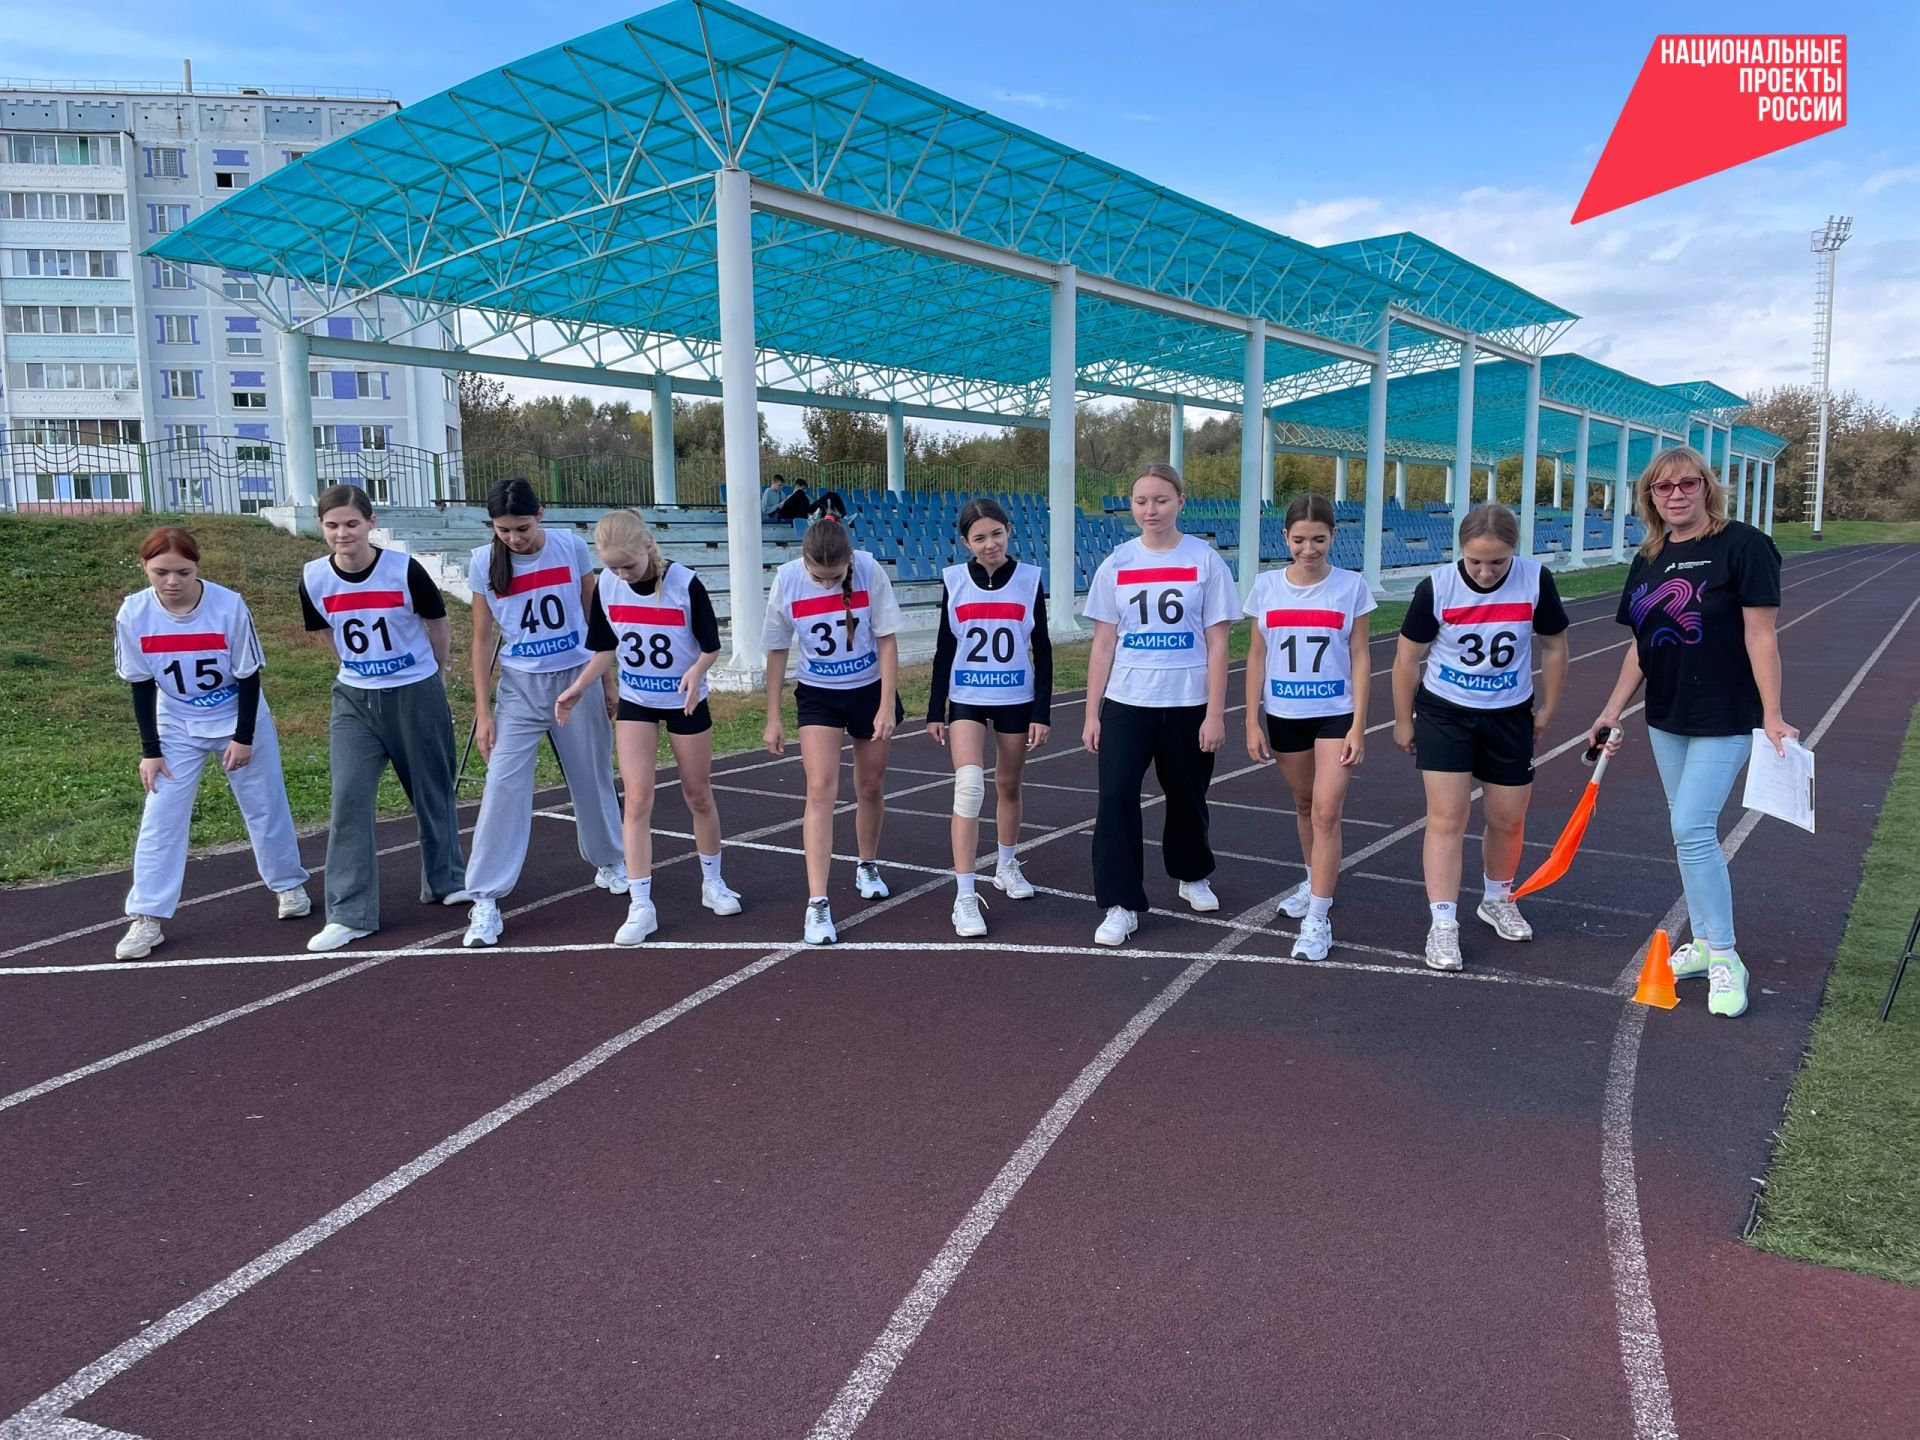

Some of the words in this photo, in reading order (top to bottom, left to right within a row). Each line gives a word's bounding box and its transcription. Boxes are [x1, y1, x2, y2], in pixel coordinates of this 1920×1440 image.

[520, 594, 565, 634] 40
[1129, 588, 1184, 625] 16
[343, 616, 393, 654] 61
[517, 634, 575, 656] ЗАИНСК
[621, 632, 674, 669] 38
[811, 617, 860, 656] 37
[966, 627, 1015, 663] 20
[1128, 635, 1187, 647] ЗАИНСК
[1458, 631, 1518, 668] 36
[1280, 635, 1331, 673] 17
[163, 658, 223, 694] 15
[963, 673, 1019, 685] ЗАИНСК
[1276, 683, 1336, 697] ЗАИНСК
[1447, 670, 1514, 689] ЗАИНСК
